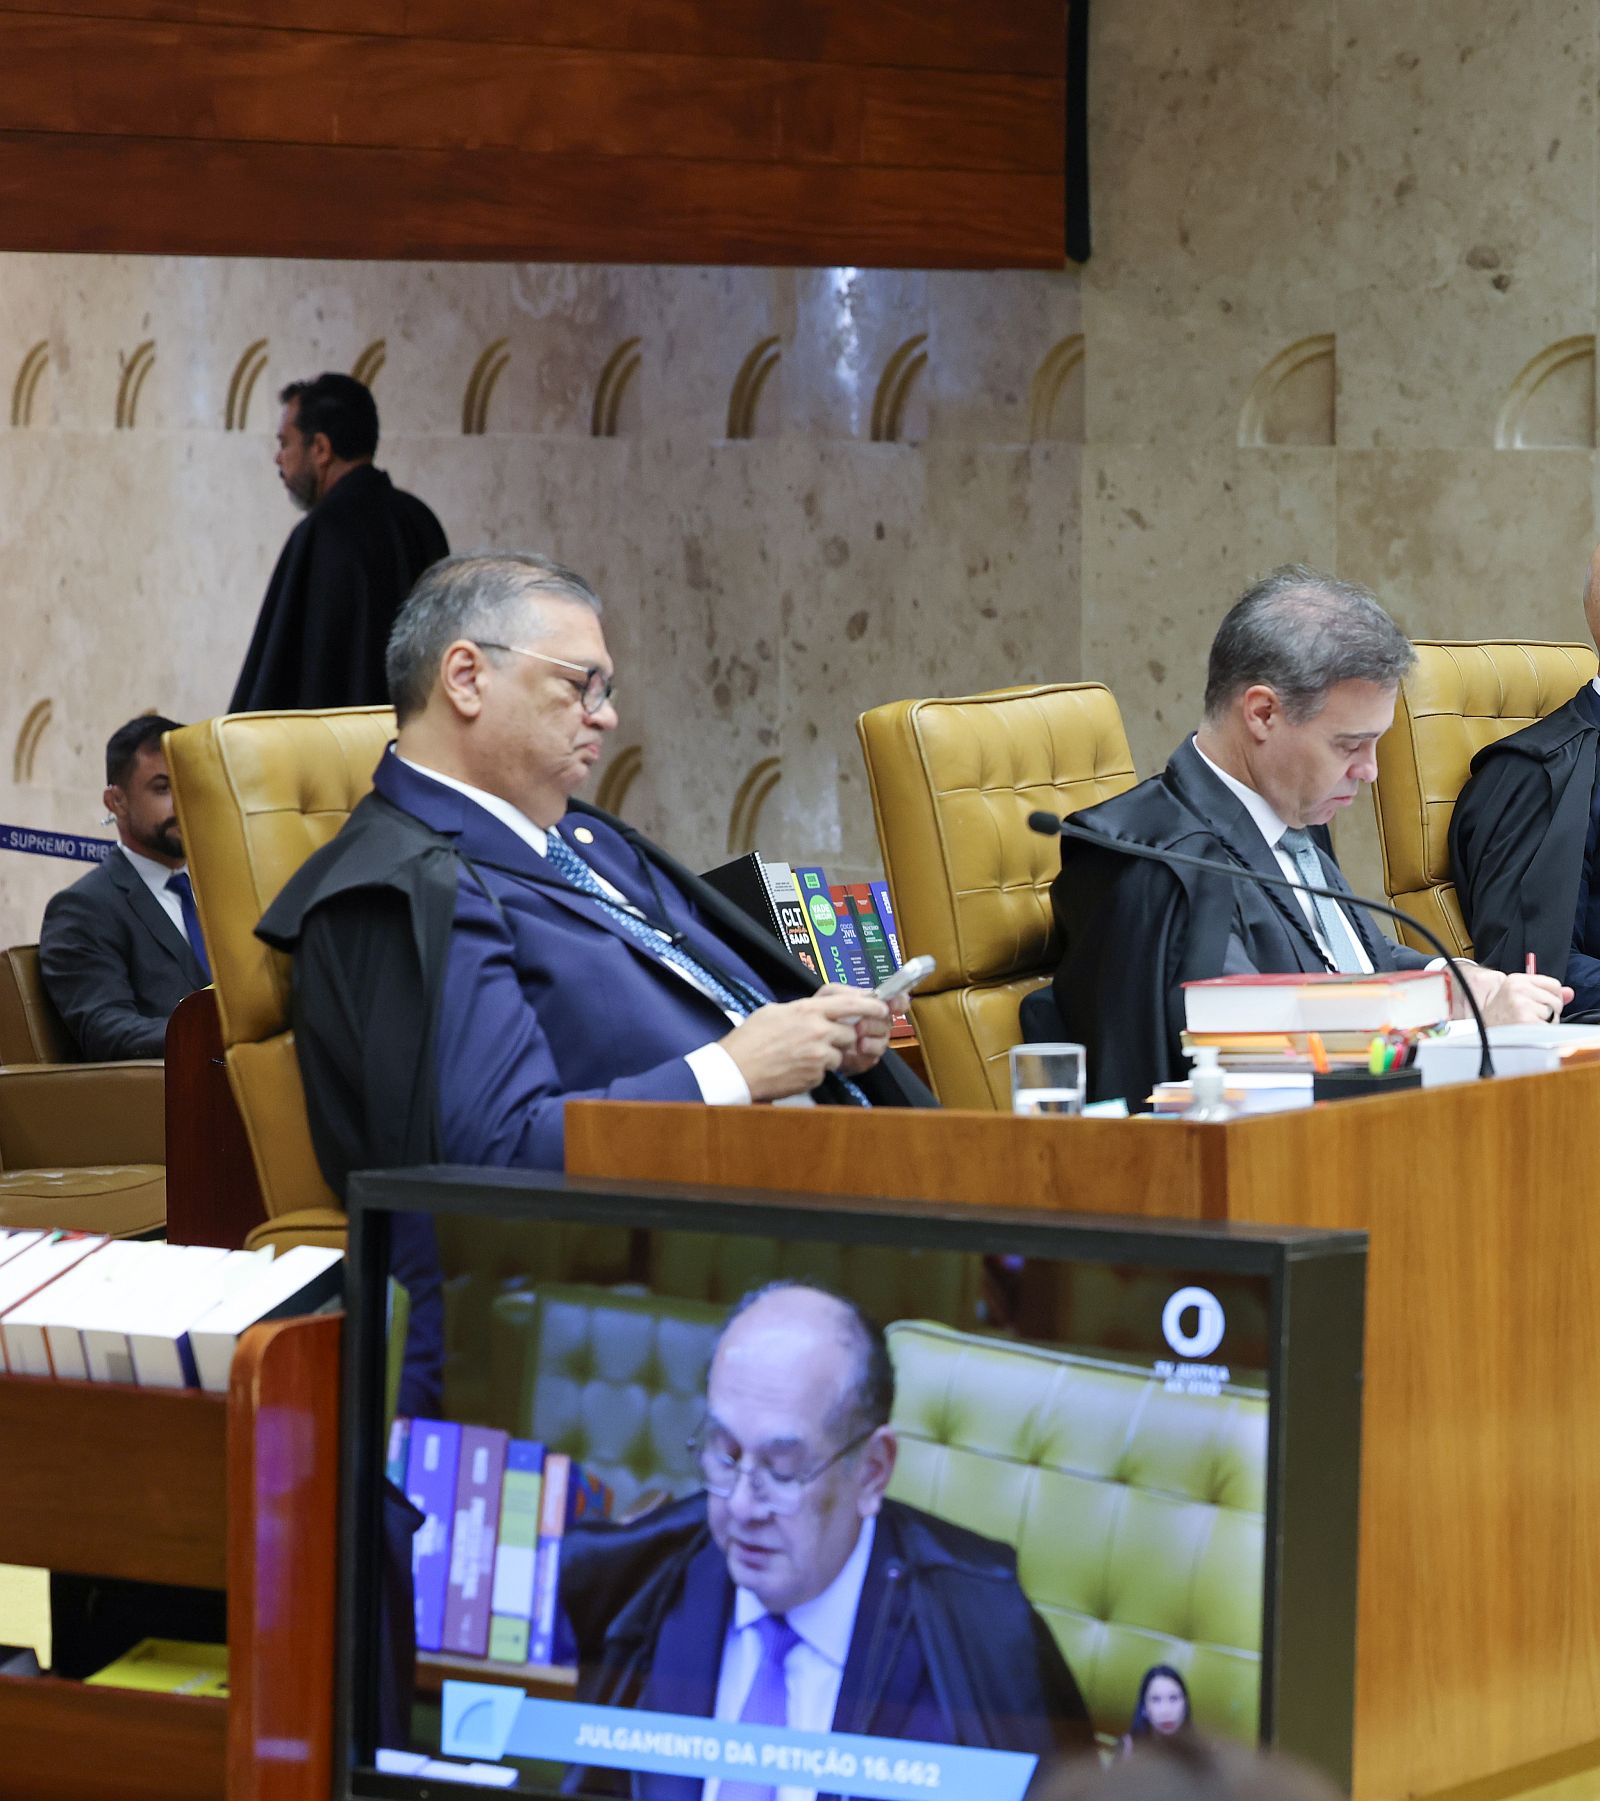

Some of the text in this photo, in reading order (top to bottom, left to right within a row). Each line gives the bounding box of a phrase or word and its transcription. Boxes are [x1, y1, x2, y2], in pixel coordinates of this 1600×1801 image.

[9, 831, 76, 856] SUPREMO
[79, 841, 115, 859] TRIB
[782, 908, 804, 927] CLT
[811, 904, 830, 913] VADE
[788, 933, 810, 945] SAAD
[830, 946, 848, 984] aiva
[575, 1723, 941, 1788] JULGAMENTO DA PETIÇÃO 16.662
